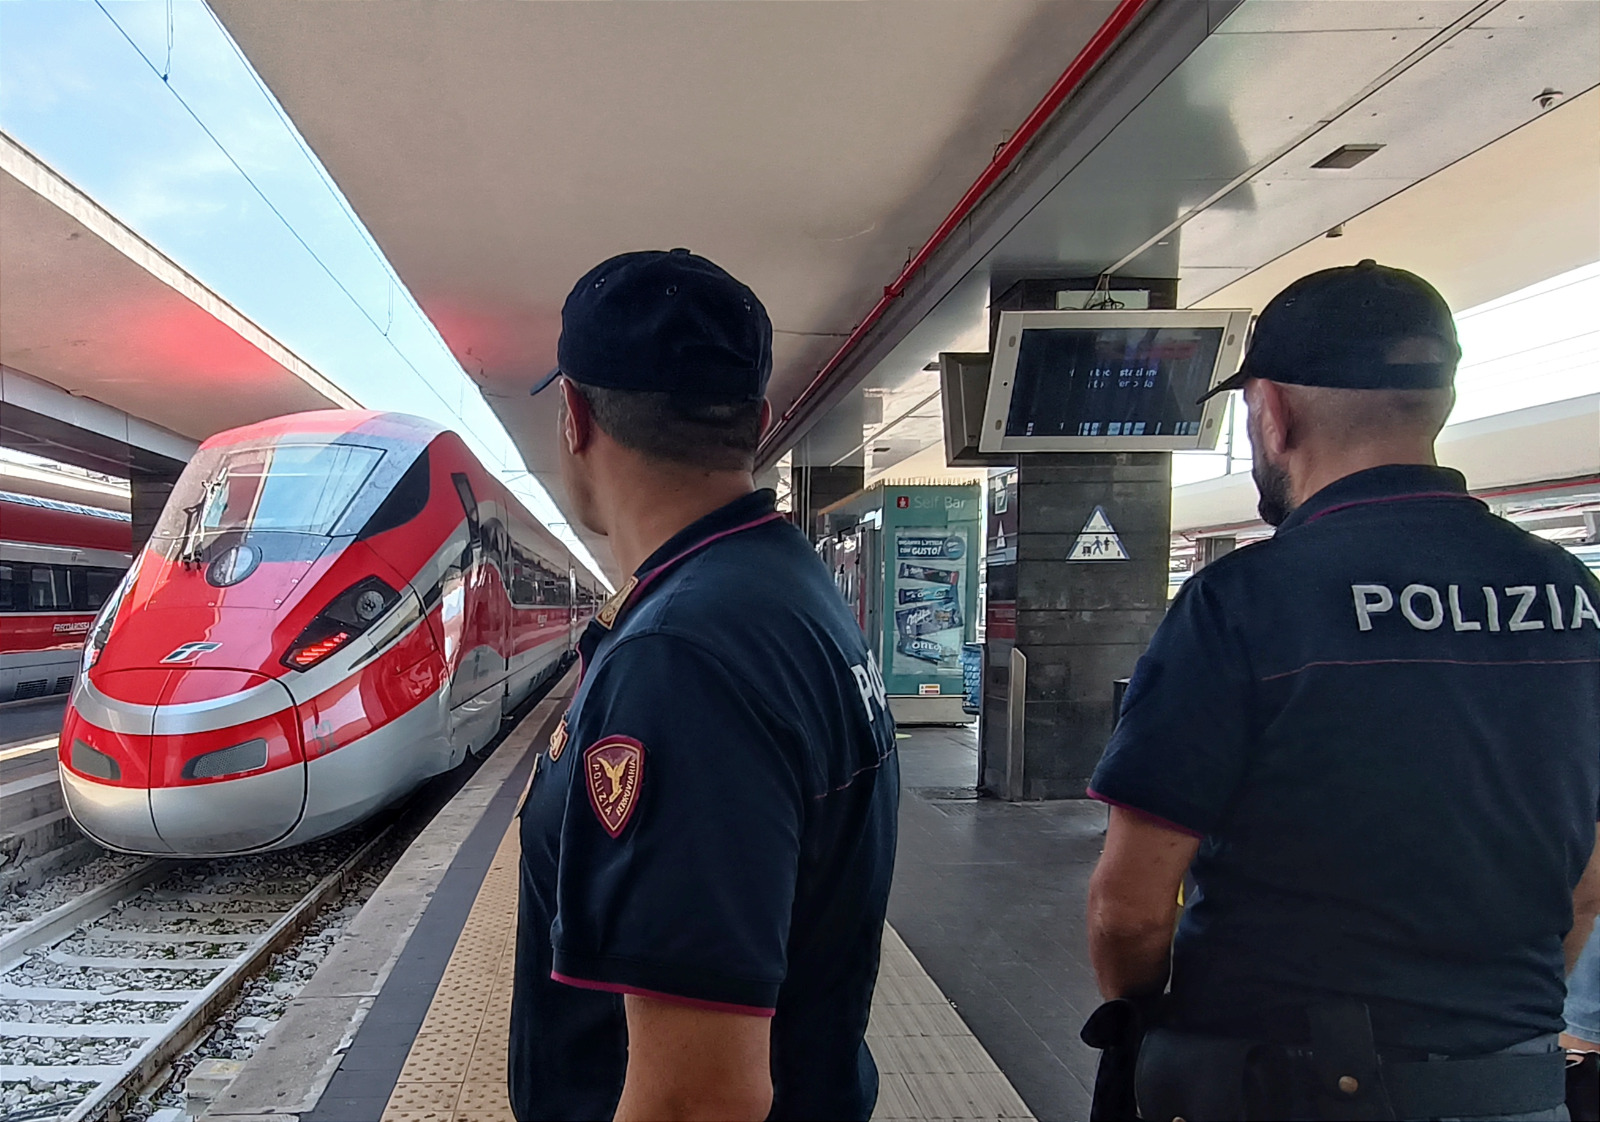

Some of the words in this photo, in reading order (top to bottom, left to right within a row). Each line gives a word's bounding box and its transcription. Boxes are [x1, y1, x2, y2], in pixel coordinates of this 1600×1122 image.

[914, 495, 939, 509] Self
[945, 496, 966, 509] Bar
[911, 547, 942, 556] GUSTO!
[1351, 583, 1600, 632] POLIZIA
[592, 763, 613, 816] POLIZIA
